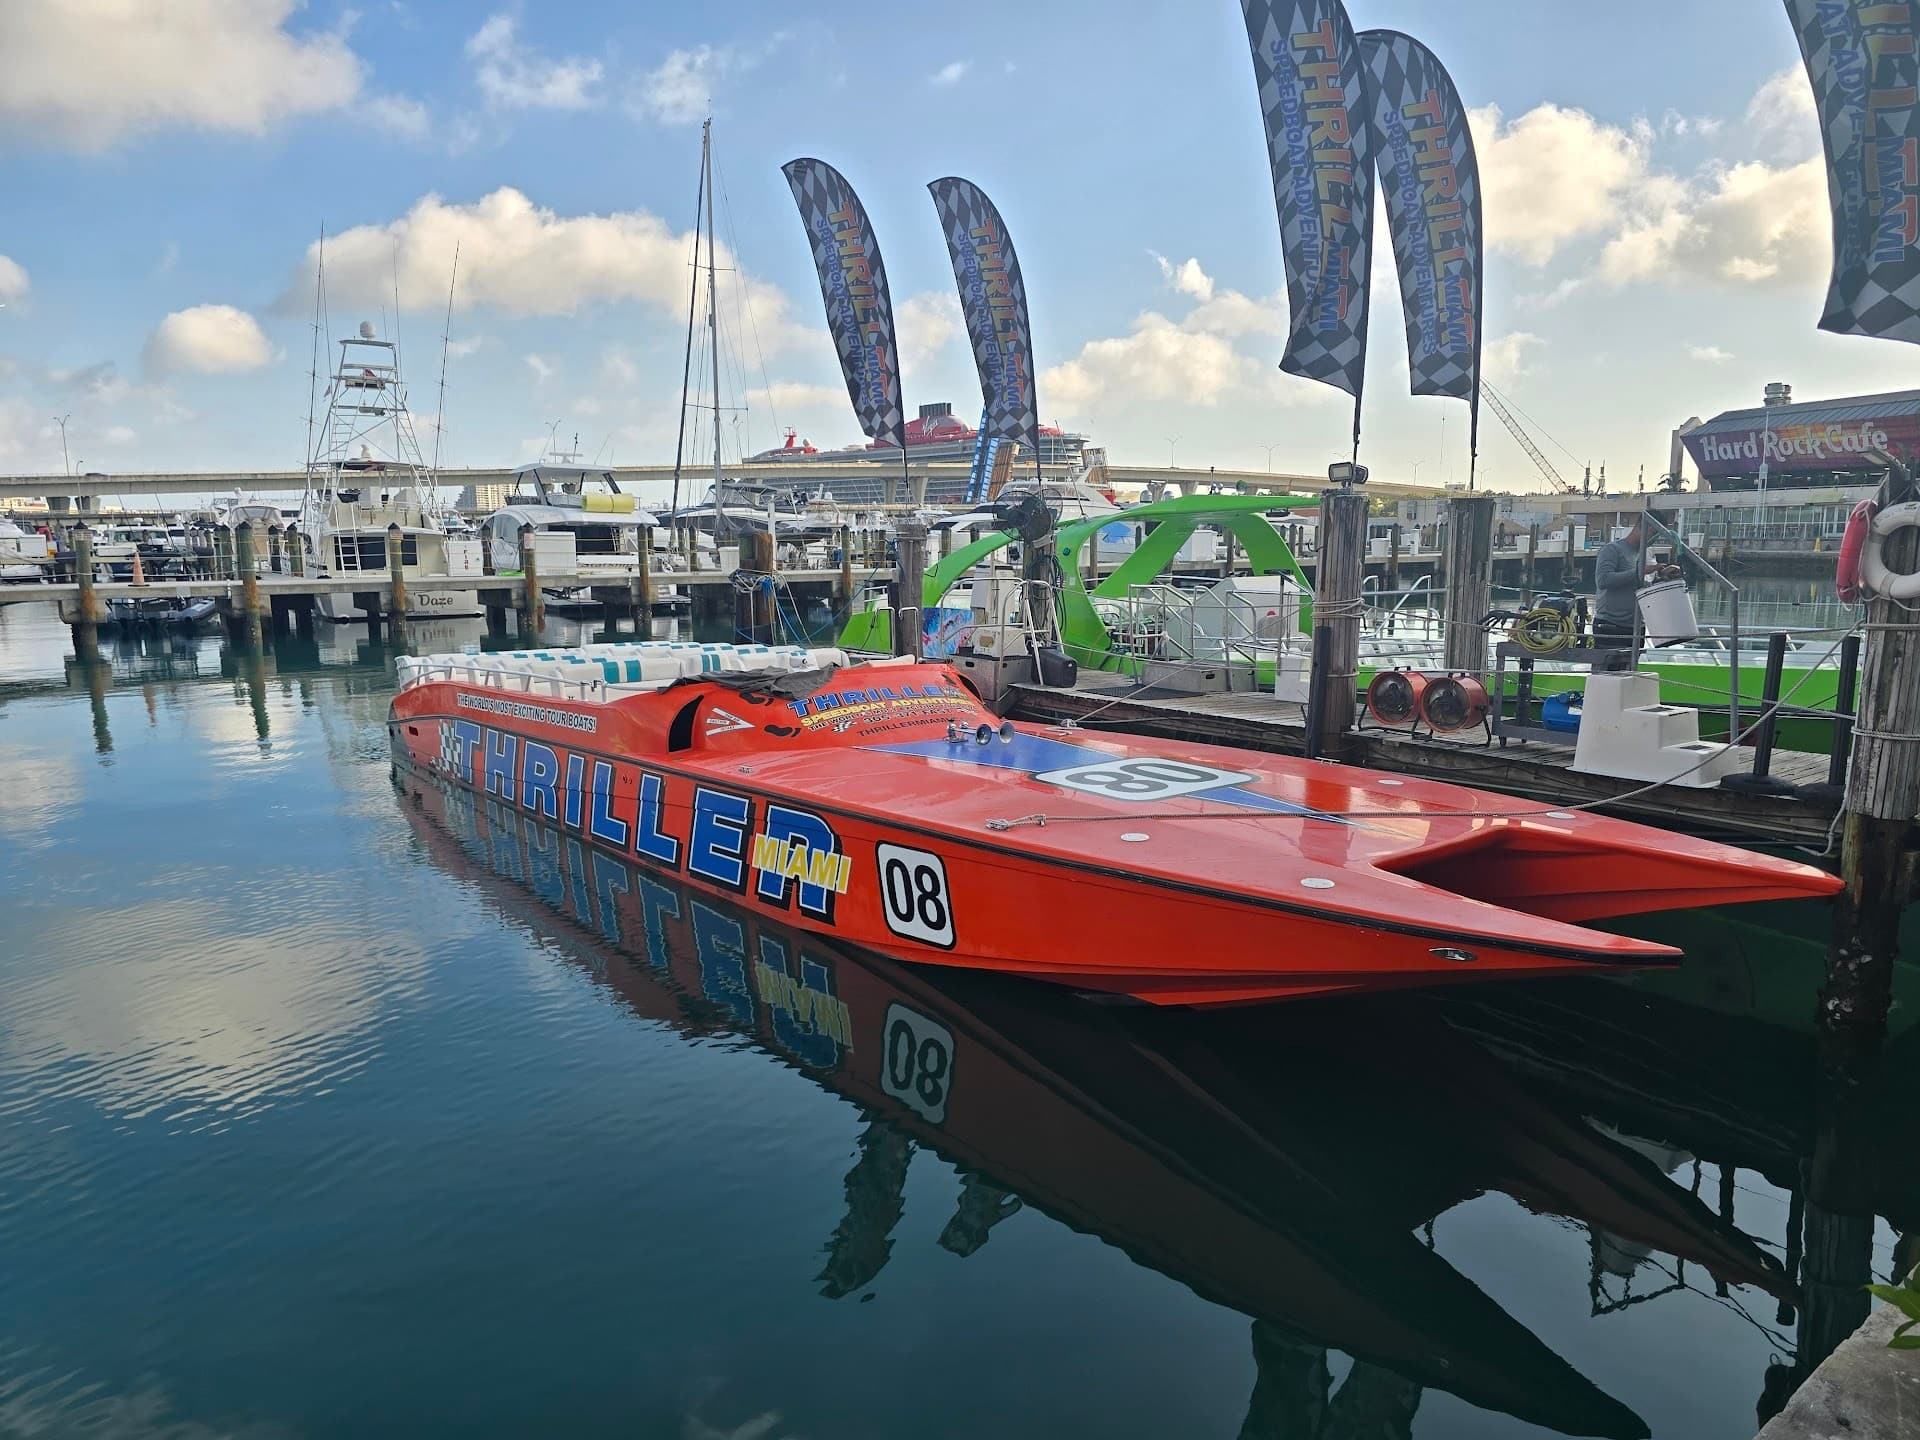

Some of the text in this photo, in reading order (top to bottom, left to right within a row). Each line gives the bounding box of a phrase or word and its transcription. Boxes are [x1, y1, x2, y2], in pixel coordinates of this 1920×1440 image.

[1270, 40, 1309, 169] SPEEDBOAT
[1384, 111, 1423, 224] SPEEDBOAT
[1875, 135, 1905, 263] MIAMI
[816, 219, 846, 299] SPEEDBOAT
[958, 233, 986, 310] SPEEDBOAT
[1319, 240, 1342, 330] MIAMI
[1408, 230, 1437, 355] ADVENTURES
[1444, 273, 1468, 354] MIAMI
[866, 344, 886, 405] MIAMI
[1003, 351, 1022, 409] MIAMI
[1700, 421, 1888, 463] Hard Rock Cafe
[417, 593, 454, 608] Daze
[457, 693, 597, 733] THE WORLD'S MOST EXCITING TOUR BOATS!
[801, 702, 888, 727] SPEEDBOAT
[454, 719, 838, 922] THRILLER
[751, 833, 853, 895] MIAMI
[886, 858, 947, 931] 08
